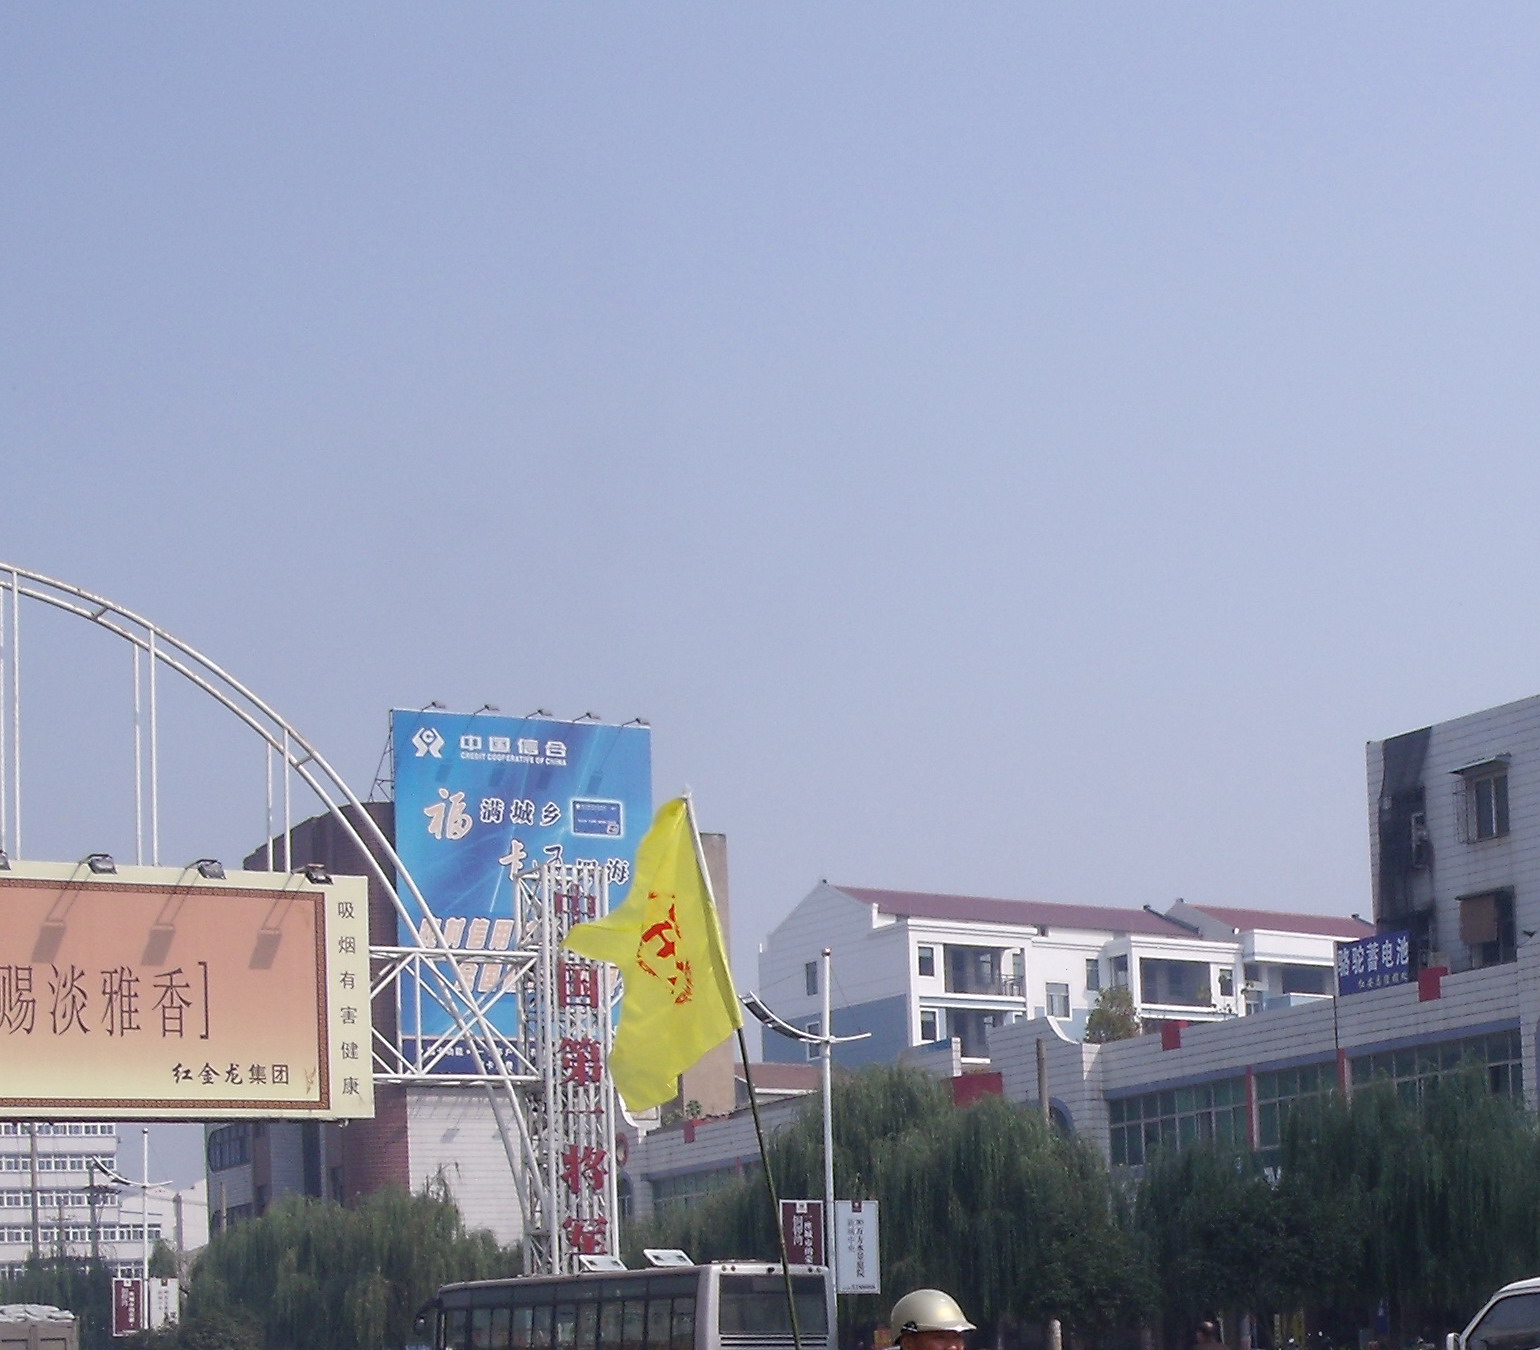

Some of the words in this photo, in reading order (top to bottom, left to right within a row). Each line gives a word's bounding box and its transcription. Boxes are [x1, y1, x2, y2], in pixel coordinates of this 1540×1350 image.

[460, 735, 567, 757] 中国信合
[460, 751, 486, 760] CREDIT
[487, 753, 534, 763] COOPERATIVE
[545, 757, 567, 766] CHINA
[424, 788, 561, 840] 福满城乡
[1338, 936, 1409, 977] 骆驼蓄电池
[338, 901, 360, 1096] 吸烟有害健康
[172, 1062, 290, 1086] 红金龙集团
